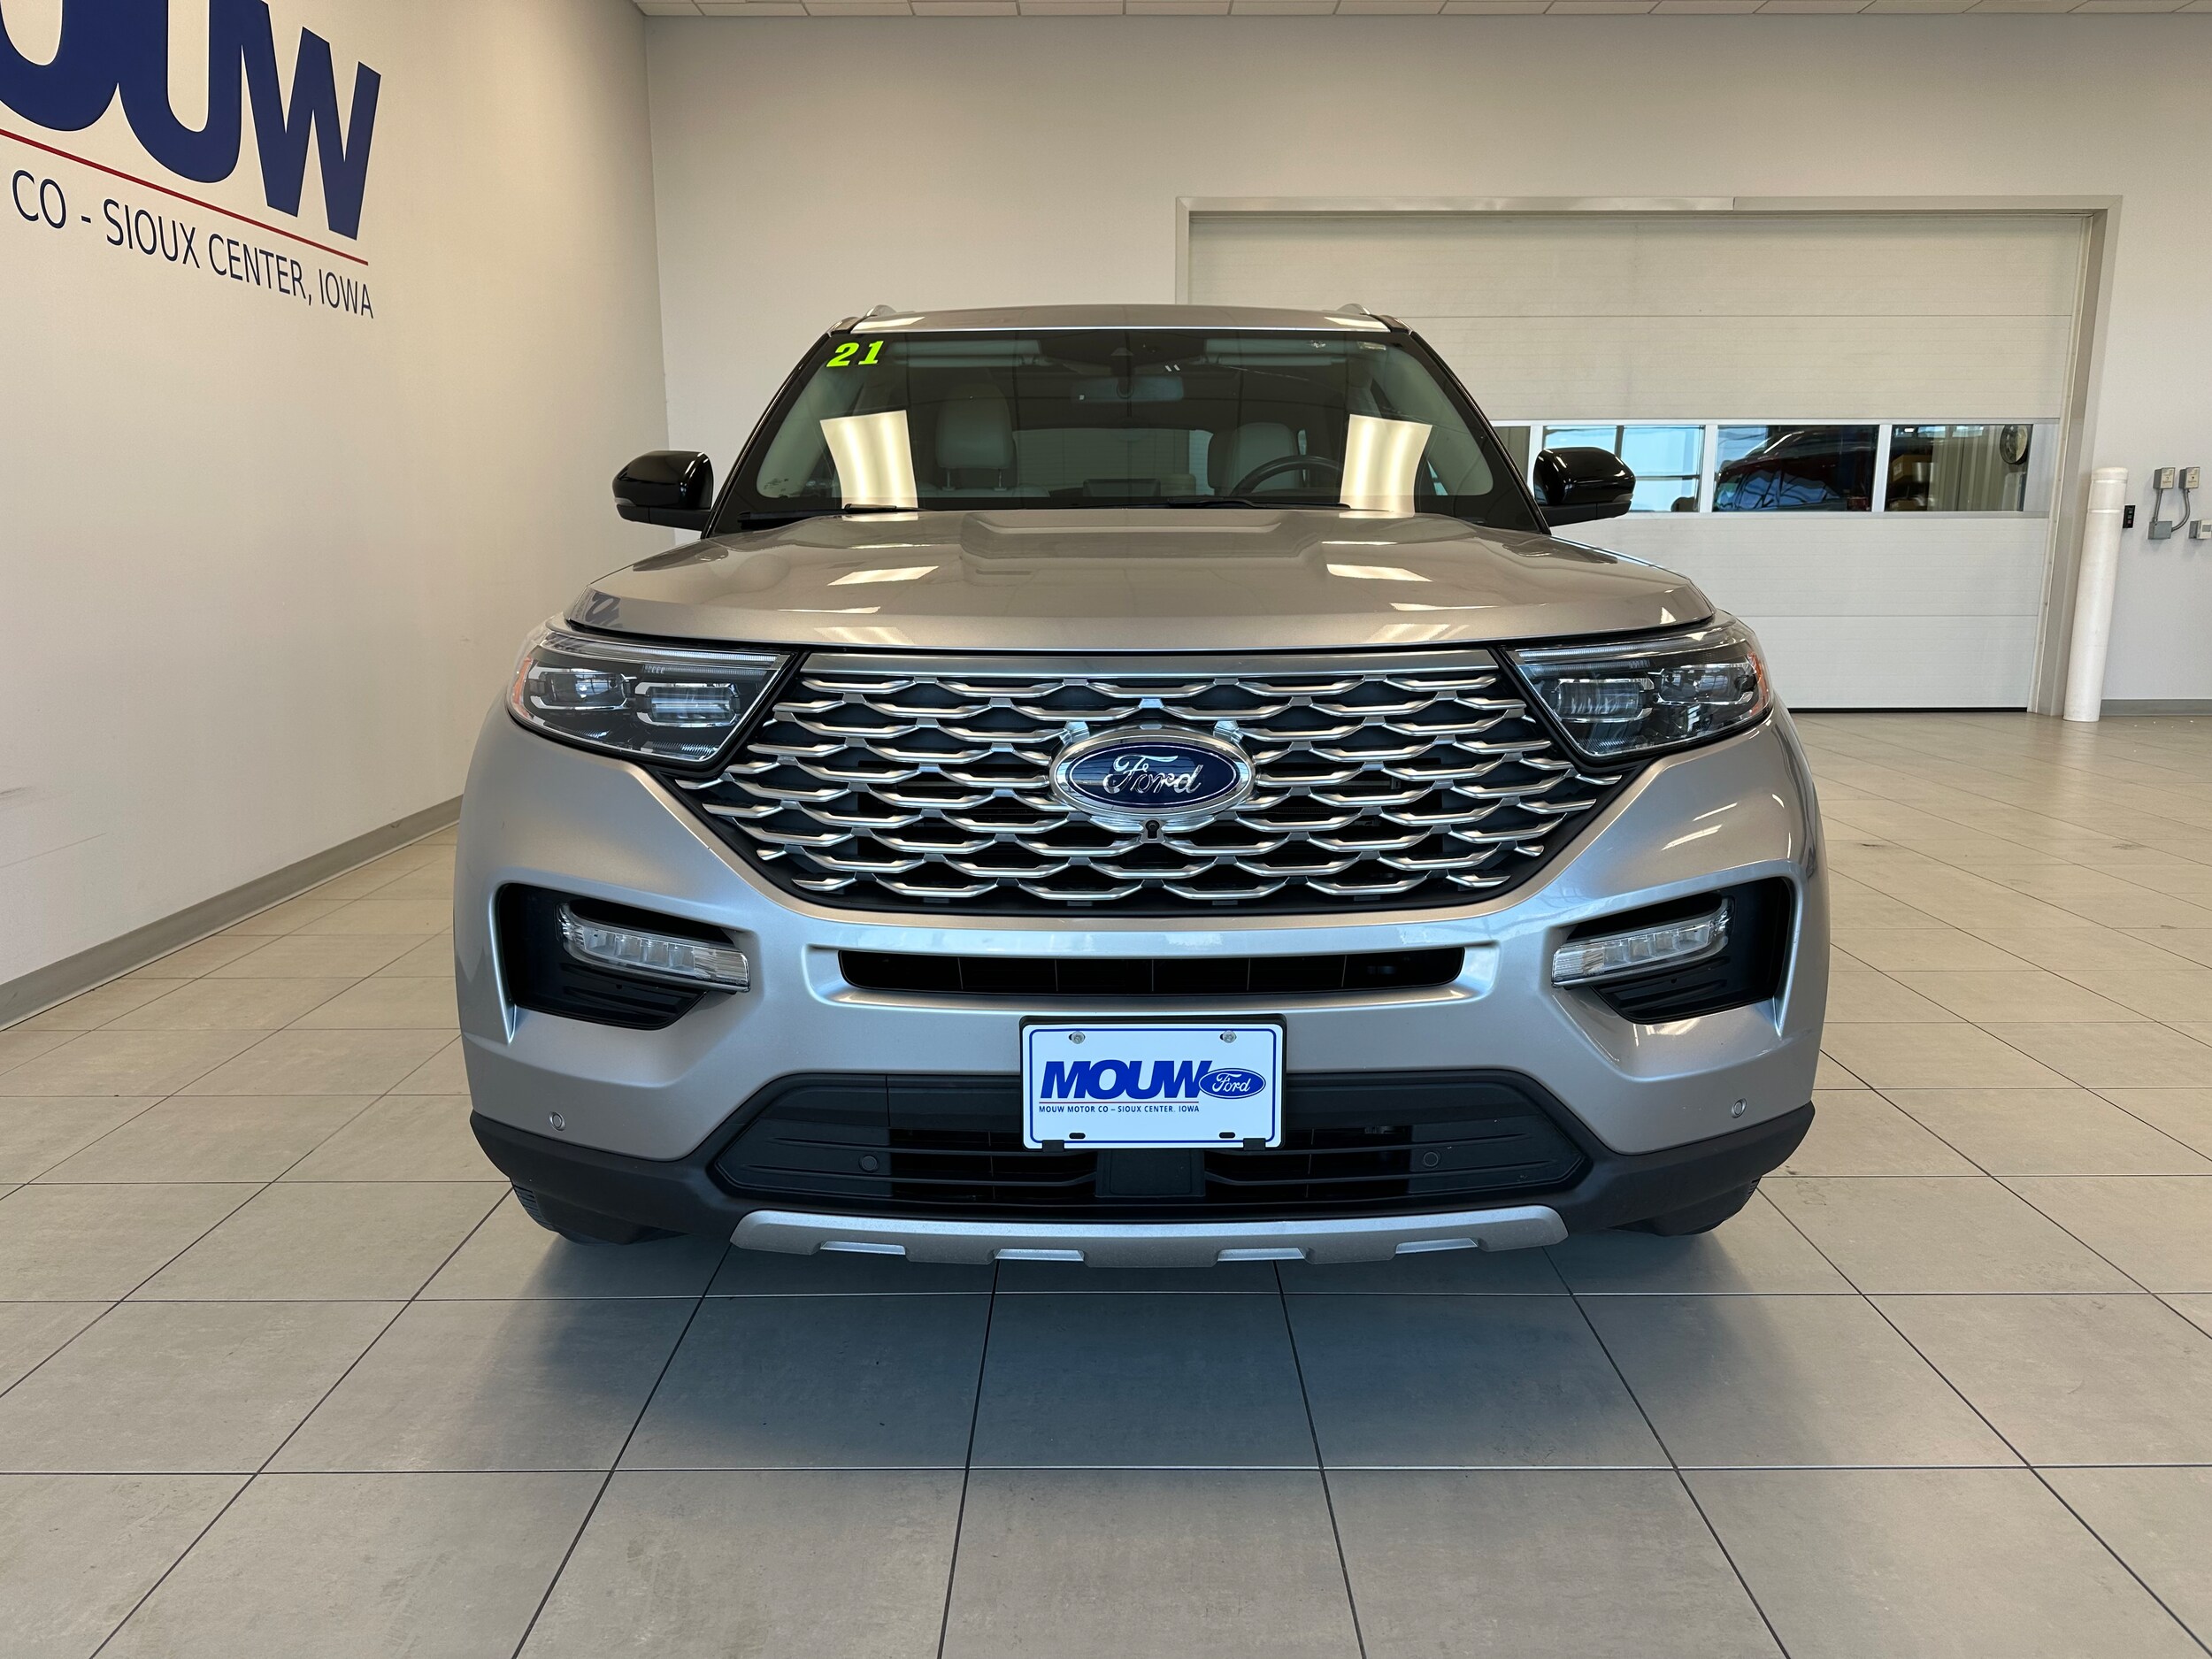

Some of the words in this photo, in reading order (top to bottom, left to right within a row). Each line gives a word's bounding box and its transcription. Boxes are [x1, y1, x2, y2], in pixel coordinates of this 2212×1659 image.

[12, 170, 66, 229] CO
[104, 199, 200, 269] SIOUX
[209, 234, 312, 306] CENTER,
[319, 269, 374, 319] IOWA
[827, 340, 884, 367] 21
[1102, 754, 1204, 795] Ford
[1041, 1059, 1212, 1100] MOUW
[1211, 1072, 1252, 1094] Ford
